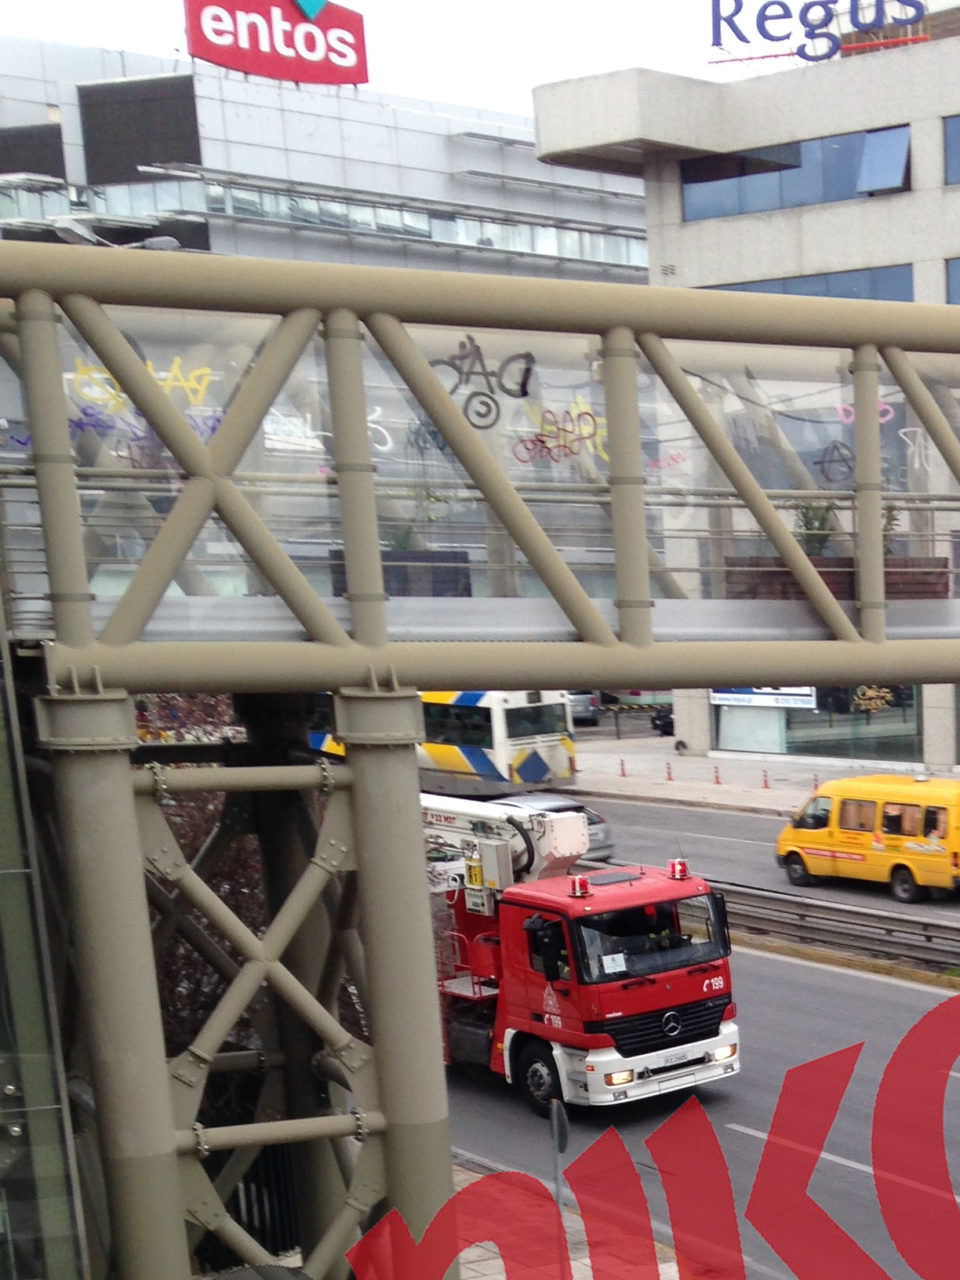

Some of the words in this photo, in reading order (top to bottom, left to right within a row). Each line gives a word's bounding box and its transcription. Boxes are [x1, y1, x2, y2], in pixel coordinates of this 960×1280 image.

[200, 5, 358, 67] entos
[711, 0, 925, 62] Regus
[710, 976, 724, 990] 199
[550, 1017, 562, 1029] 199
